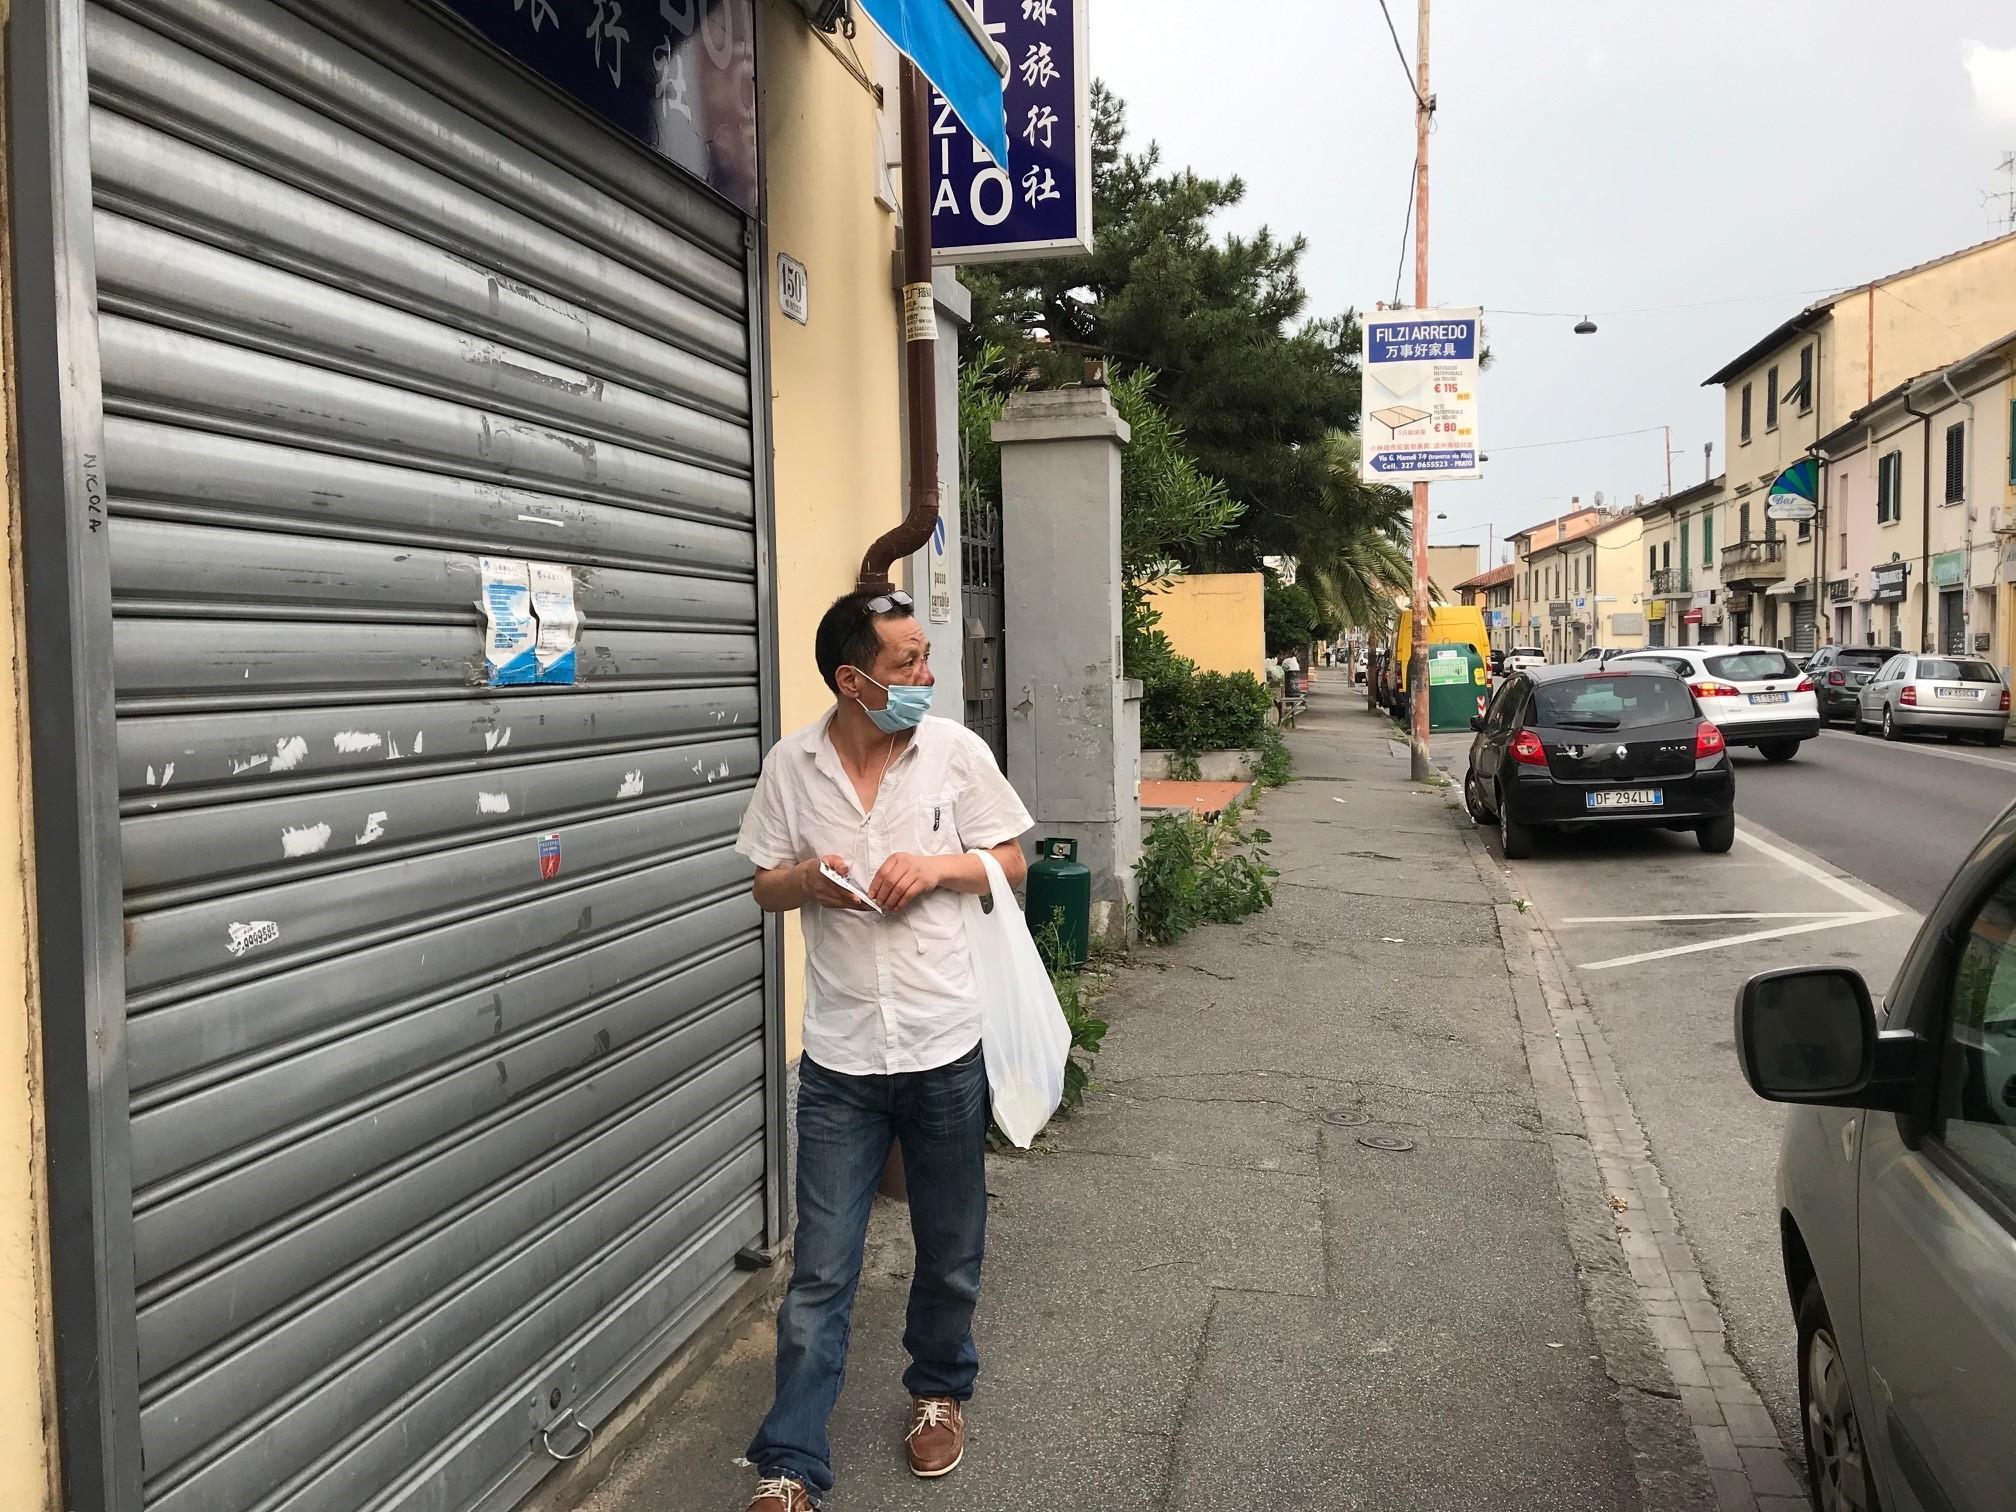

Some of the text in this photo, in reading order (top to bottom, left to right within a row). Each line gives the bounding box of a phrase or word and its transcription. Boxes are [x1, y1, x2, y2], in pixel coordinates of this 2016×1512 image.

[1376, 325, 1467, 342] FILZI ARREDO
[1385, 342, 1457, 358] 万事好家具
[1434, 383, 1458, 393] € 115
[1434, 422, 1457, 432] € 80
[1382, 462, 1398, 470] Cell.
[1401, 461, 1415, 469] 327
[1596, 791, 1654, 805] DF 294LL
